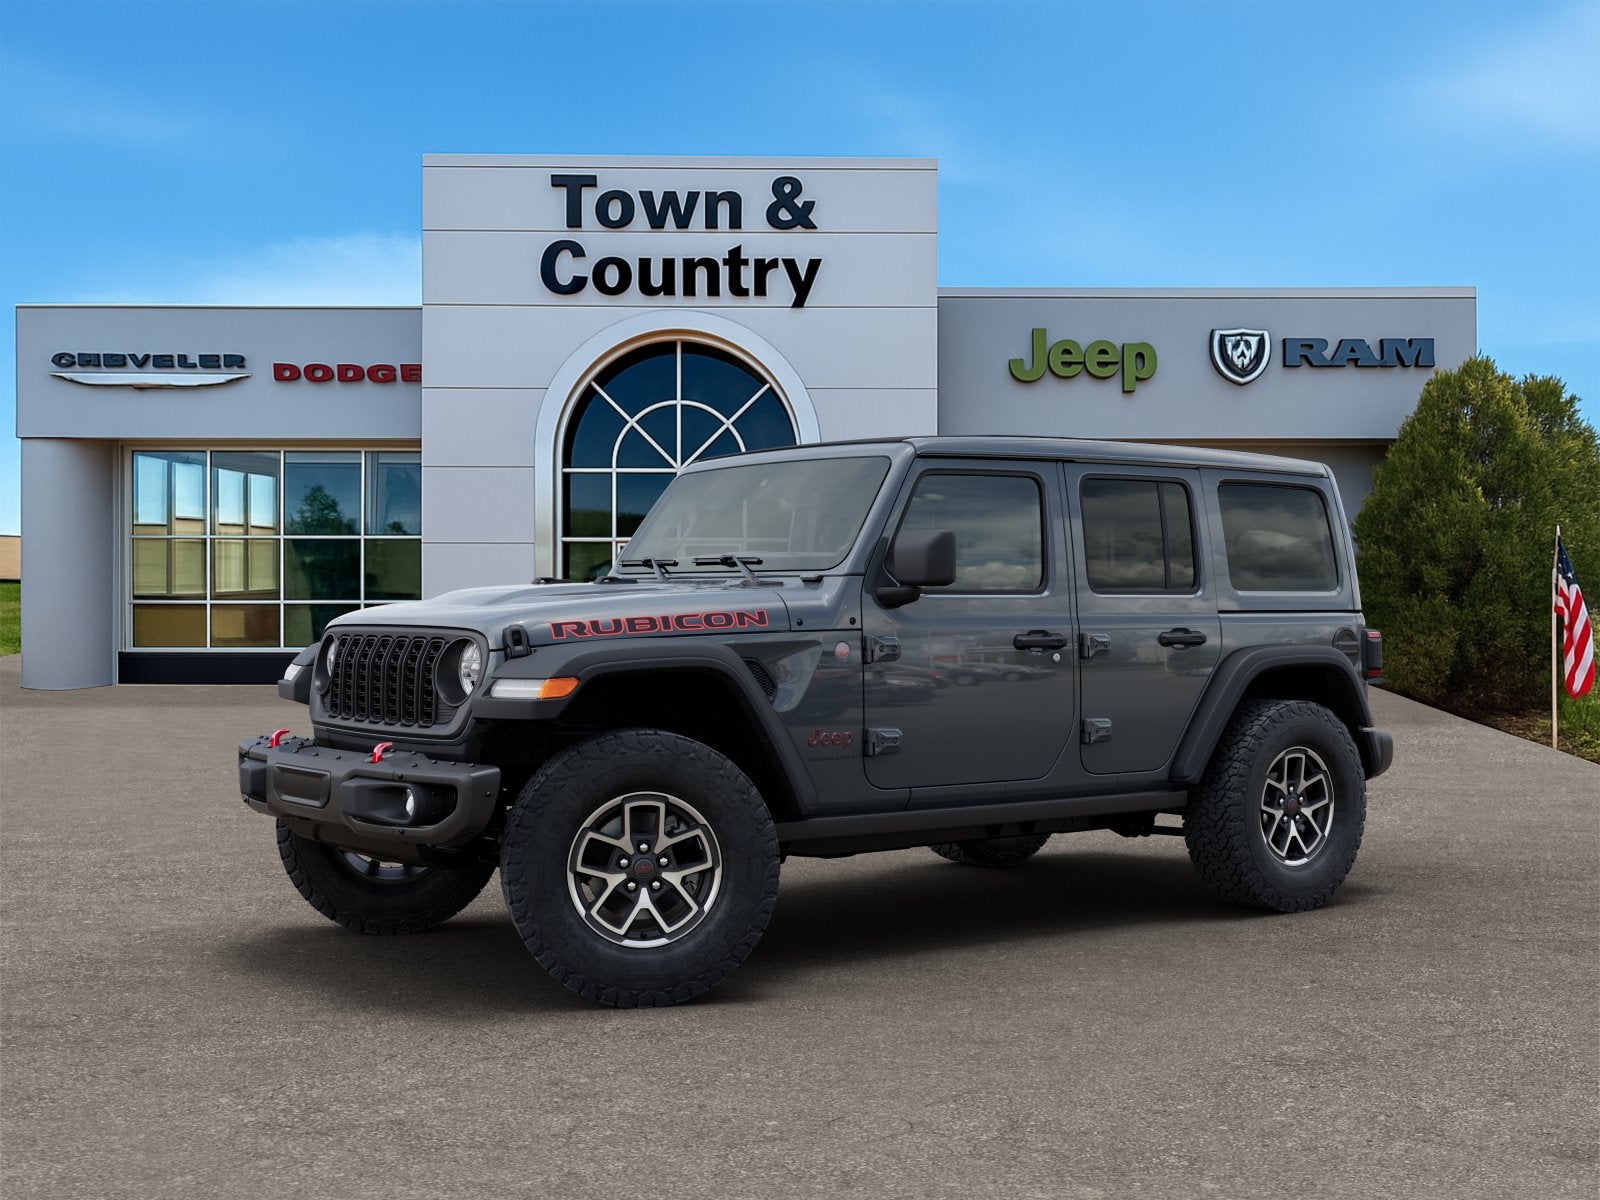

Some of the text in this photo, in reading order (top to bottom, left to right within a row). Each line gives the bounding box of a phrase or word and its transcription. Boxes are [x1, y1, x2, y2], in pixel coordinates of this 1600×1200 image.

[551, 174, 818, 229] Town &
[540, 240, 822, 308] Country
[1009, 328, 1158, 393] Jeep
[1283, 337, 1436, 368] RAM
[273, 363, 422, 382] DODGE
[551, 609, 769, 639] RUBICON
[807, 728, 853, 751] Jeep
